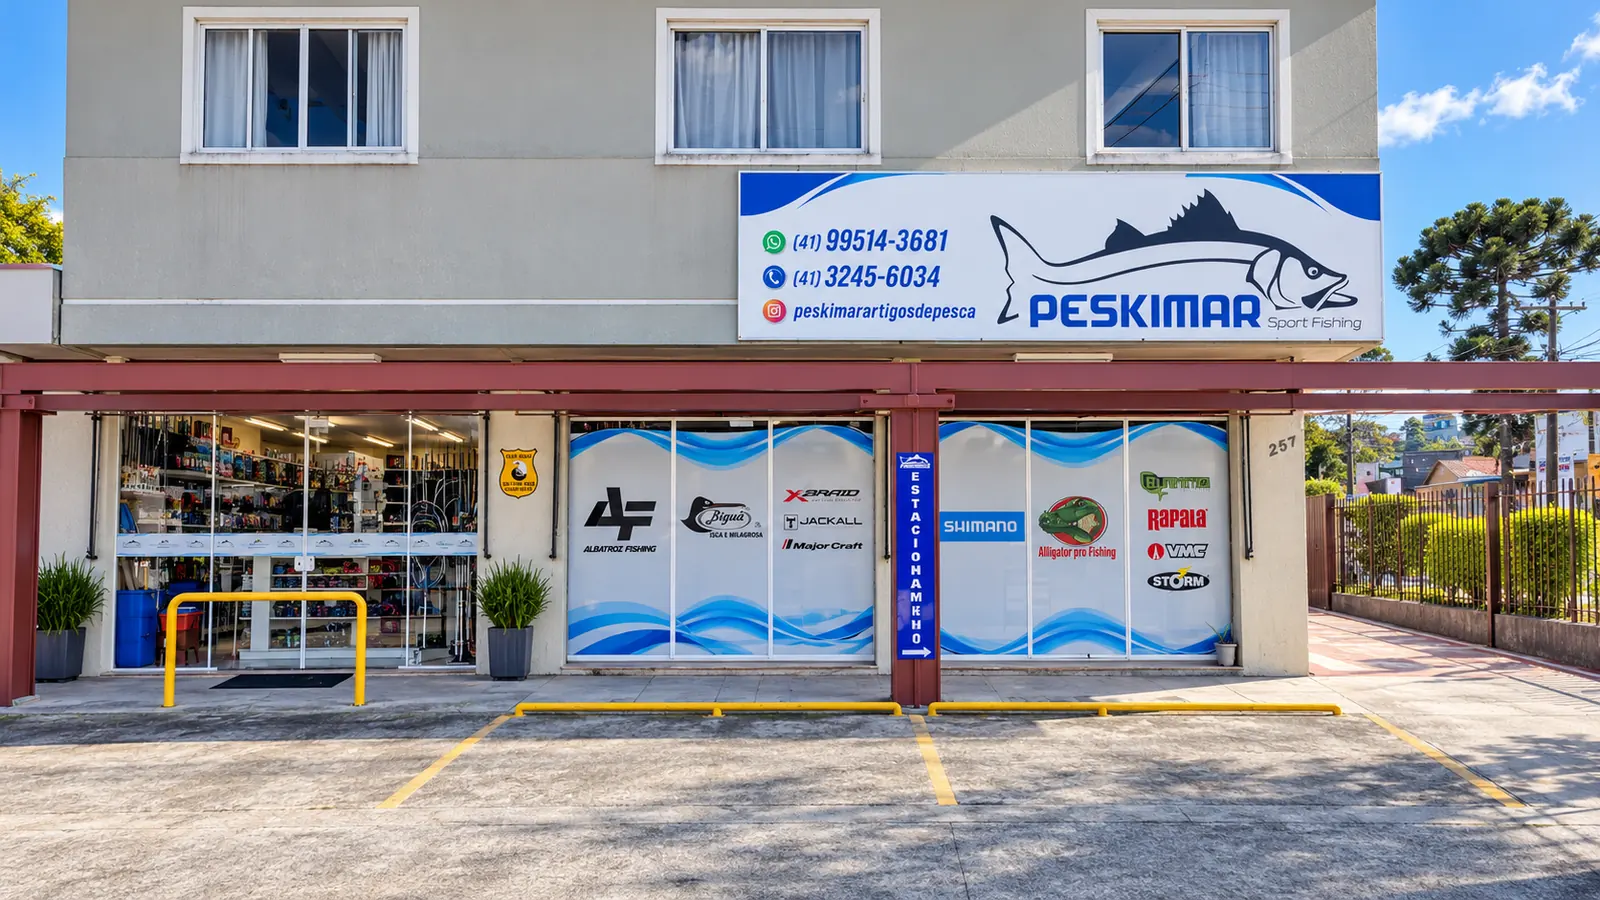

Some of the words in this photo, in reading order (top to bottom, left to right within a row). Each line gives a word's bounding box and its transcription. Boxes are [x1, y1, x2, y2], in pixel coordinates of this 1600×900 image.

[793, 234, 822, 252] (41)
[825, 228, 949, 252] 99514-3681
[793, 270, 821, 288] (41)
[824, 265, 941, 288] 3245-6034
[793, 303, 976, 322] peskimarartigosdepesca
[1029, 294, 1261, 328] PESKIMAR
[1267, 316, 1308, 331] Sport
[1311, 316, 1362, 331] Fishing
[1269, 434, 1296, 457] 257
[800, 517, 862, 525] JACKALL
[944, 520, 1017, 532] SHIMANO
[583, 545, 623, 553] ALBATROZ
[624, 545, 657, 553] FISHING
[793, 542, 830, 551] Major
[831, 542, 863, 550] Craft
[1038, 546, 1073, 560] Alligator
[1073, 549, 1086, 560] pro
[1088, 546, 1116, 560] Fishing
[1165, 544, 1208, 558] VMC
[1153, 573, 1204, 589] STORM
